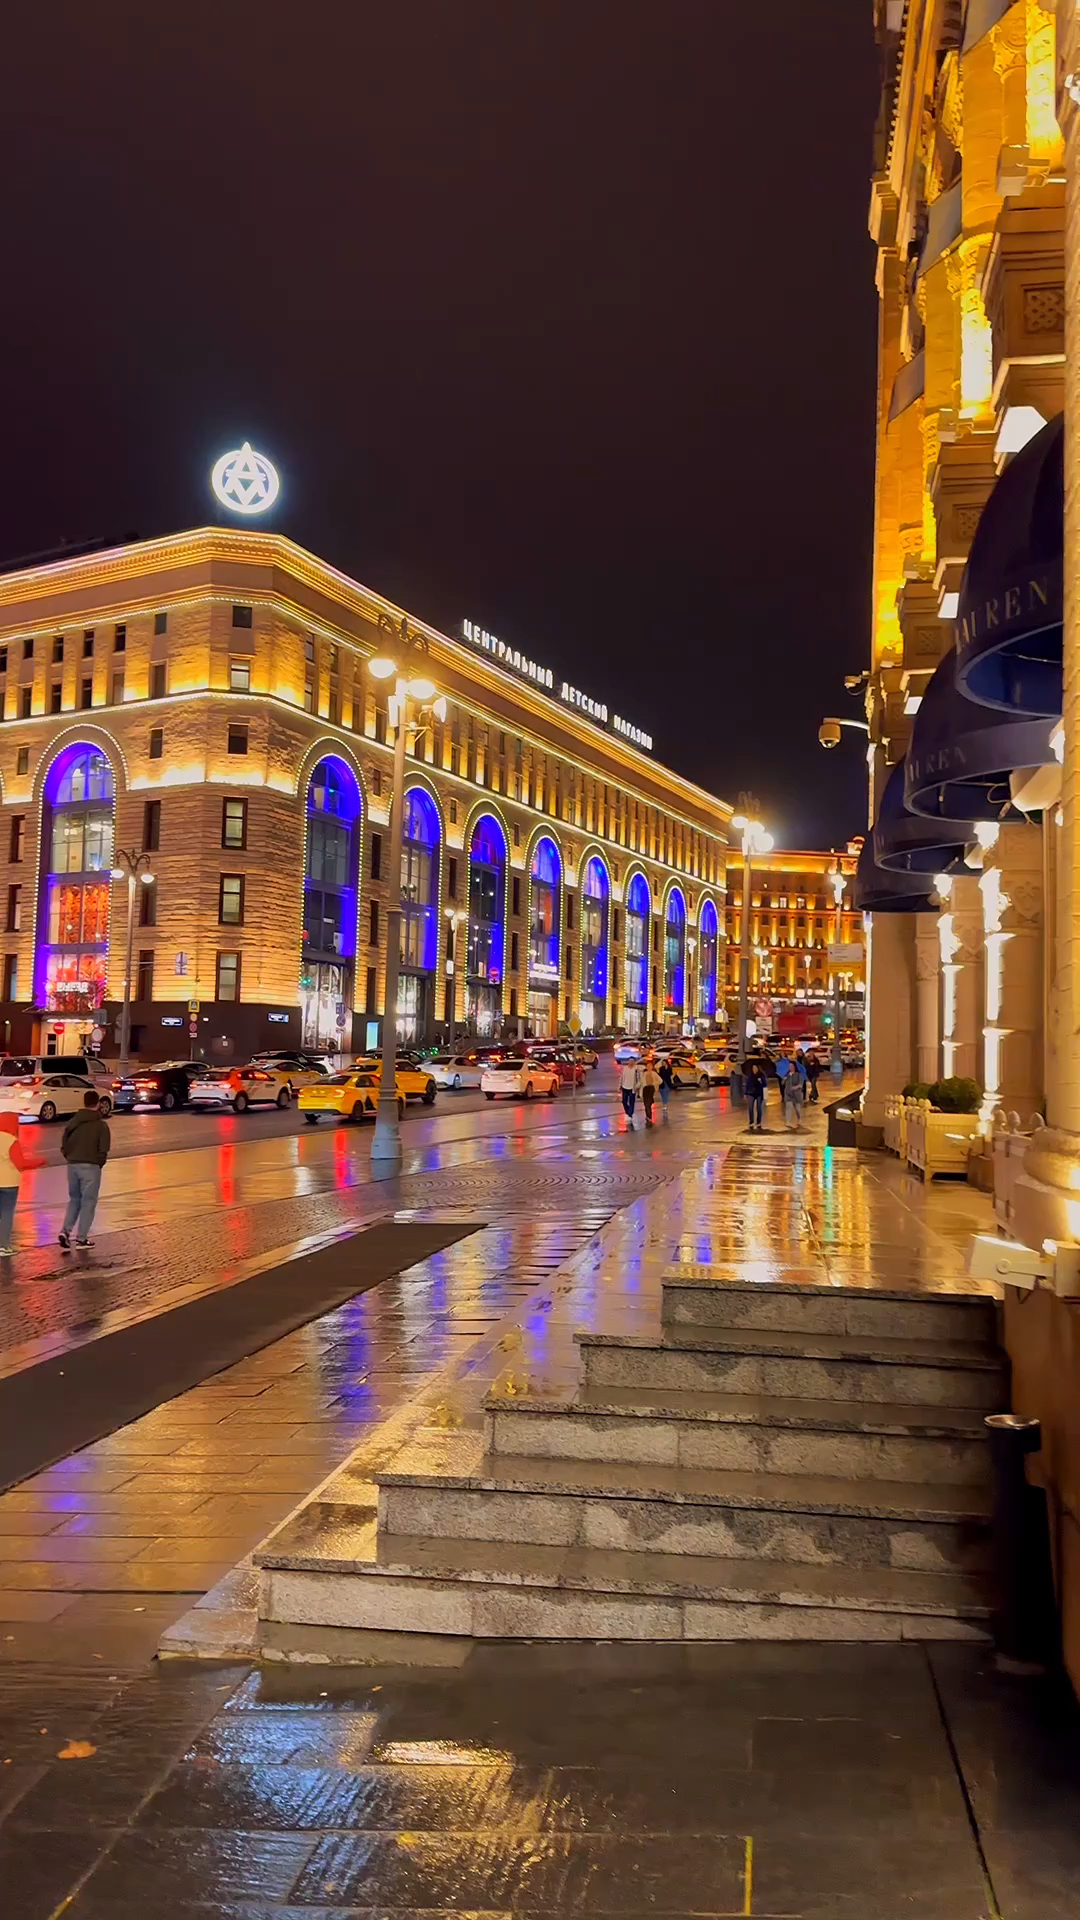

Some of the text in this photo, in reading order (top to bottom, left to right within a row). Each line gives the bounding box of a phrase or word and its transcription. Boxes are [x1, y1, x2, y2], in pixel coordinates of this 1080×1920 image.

[463, 618, 653, 751] ЦЕНТРАЛЬНЫЙ ДЕТСКИЙ МАГАЗИН
